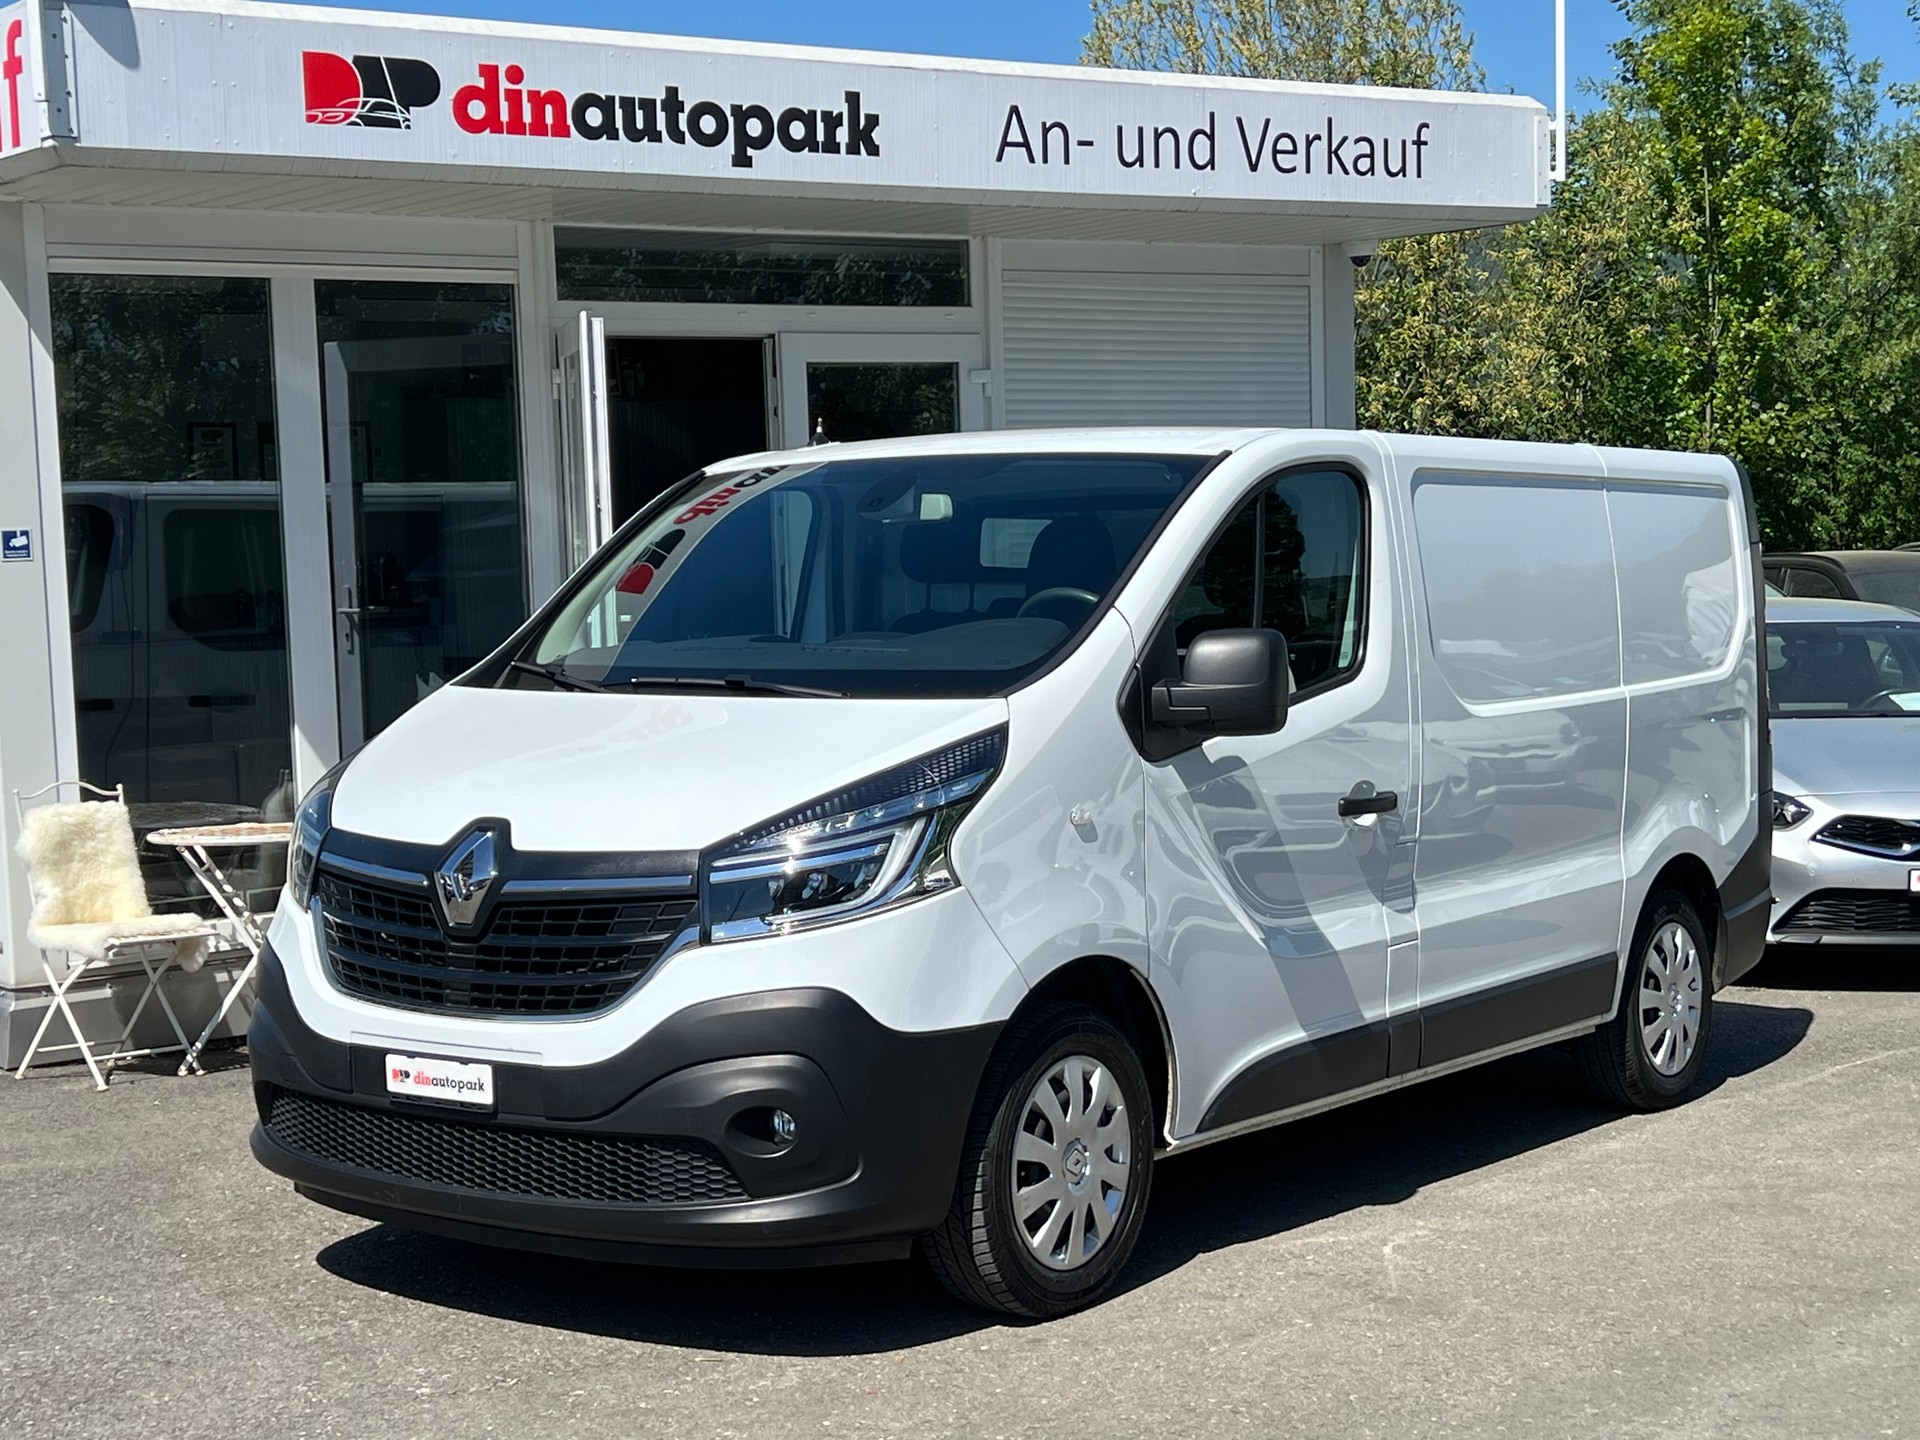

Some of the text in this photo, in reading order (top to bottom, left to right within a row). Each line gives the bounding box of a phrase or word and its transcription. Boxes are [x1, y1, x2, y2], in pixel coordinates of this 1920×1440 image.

[0, 19, 23, 148] f
[452, 64, 880, 168] dinautopark
[996, 104, 1430, 178] An- und Verkauf
[413, 1071, 484, 1093] dinautopark
